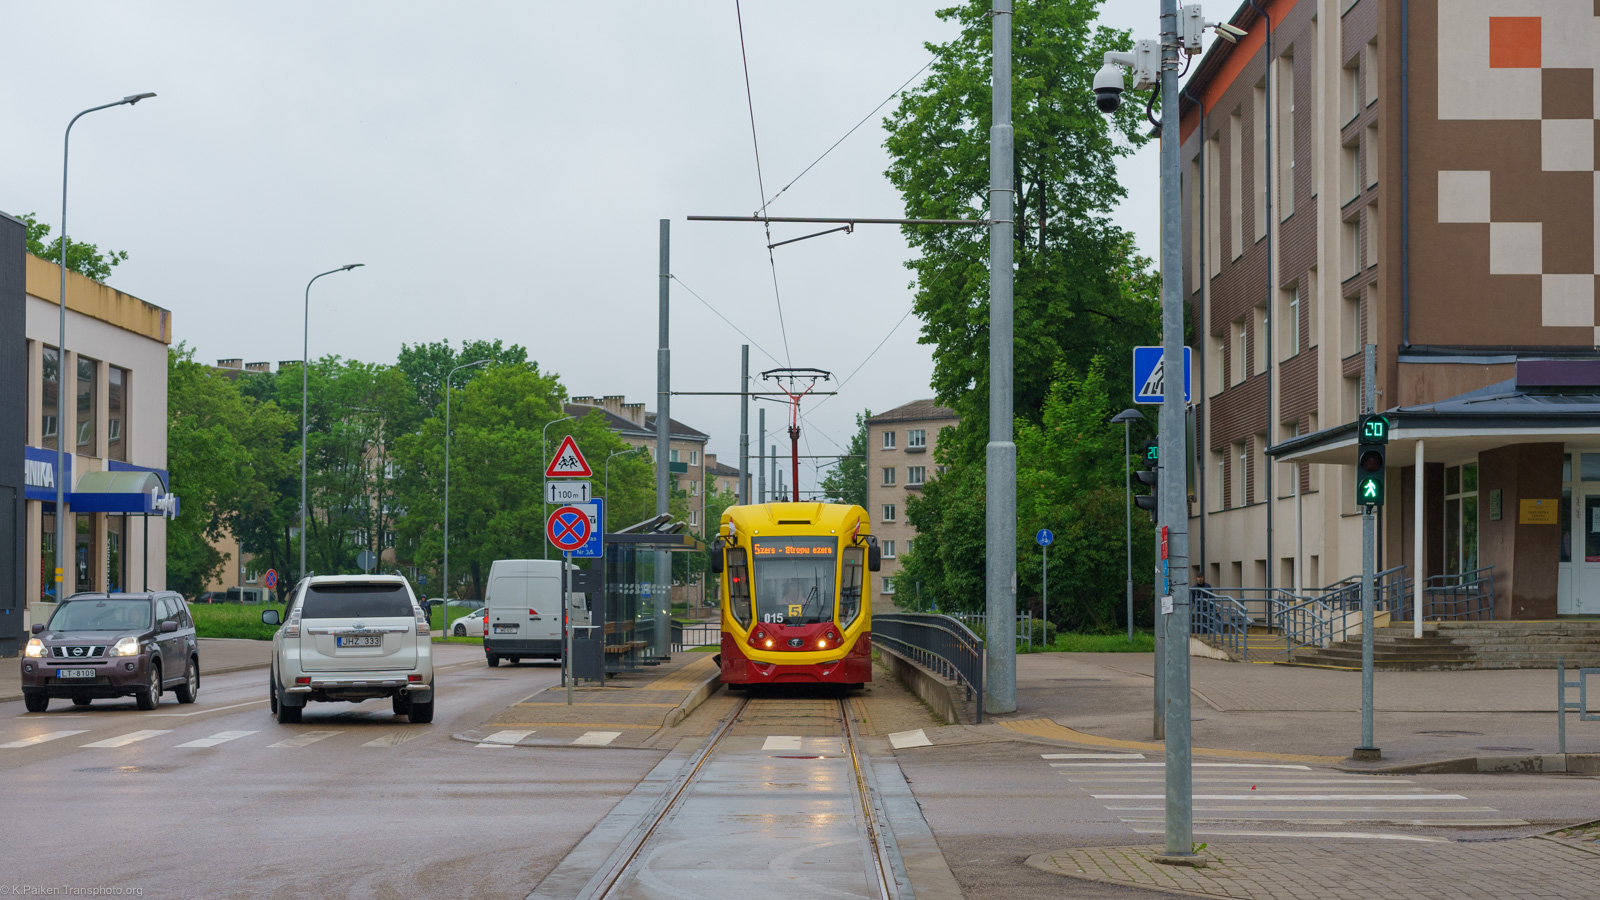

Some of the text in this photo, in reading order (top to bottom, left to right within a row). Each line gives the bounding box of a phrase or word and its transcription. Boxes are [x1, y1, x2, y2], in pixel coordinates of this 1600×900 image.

[1365, 422, 1383, 437] 20
[1147, 446, 1159, 459] 20
[558, 490, 572, 499] 100
[785, 545, 810, 555] Stropu
[812, 546, 832, 555] ezers
[791, 606, 800, 617] 5
[764, 613, 784, 623] 015
[343, 637, 380, 646] JHZ 333
[61, 670, 95, 678] LT-8109
